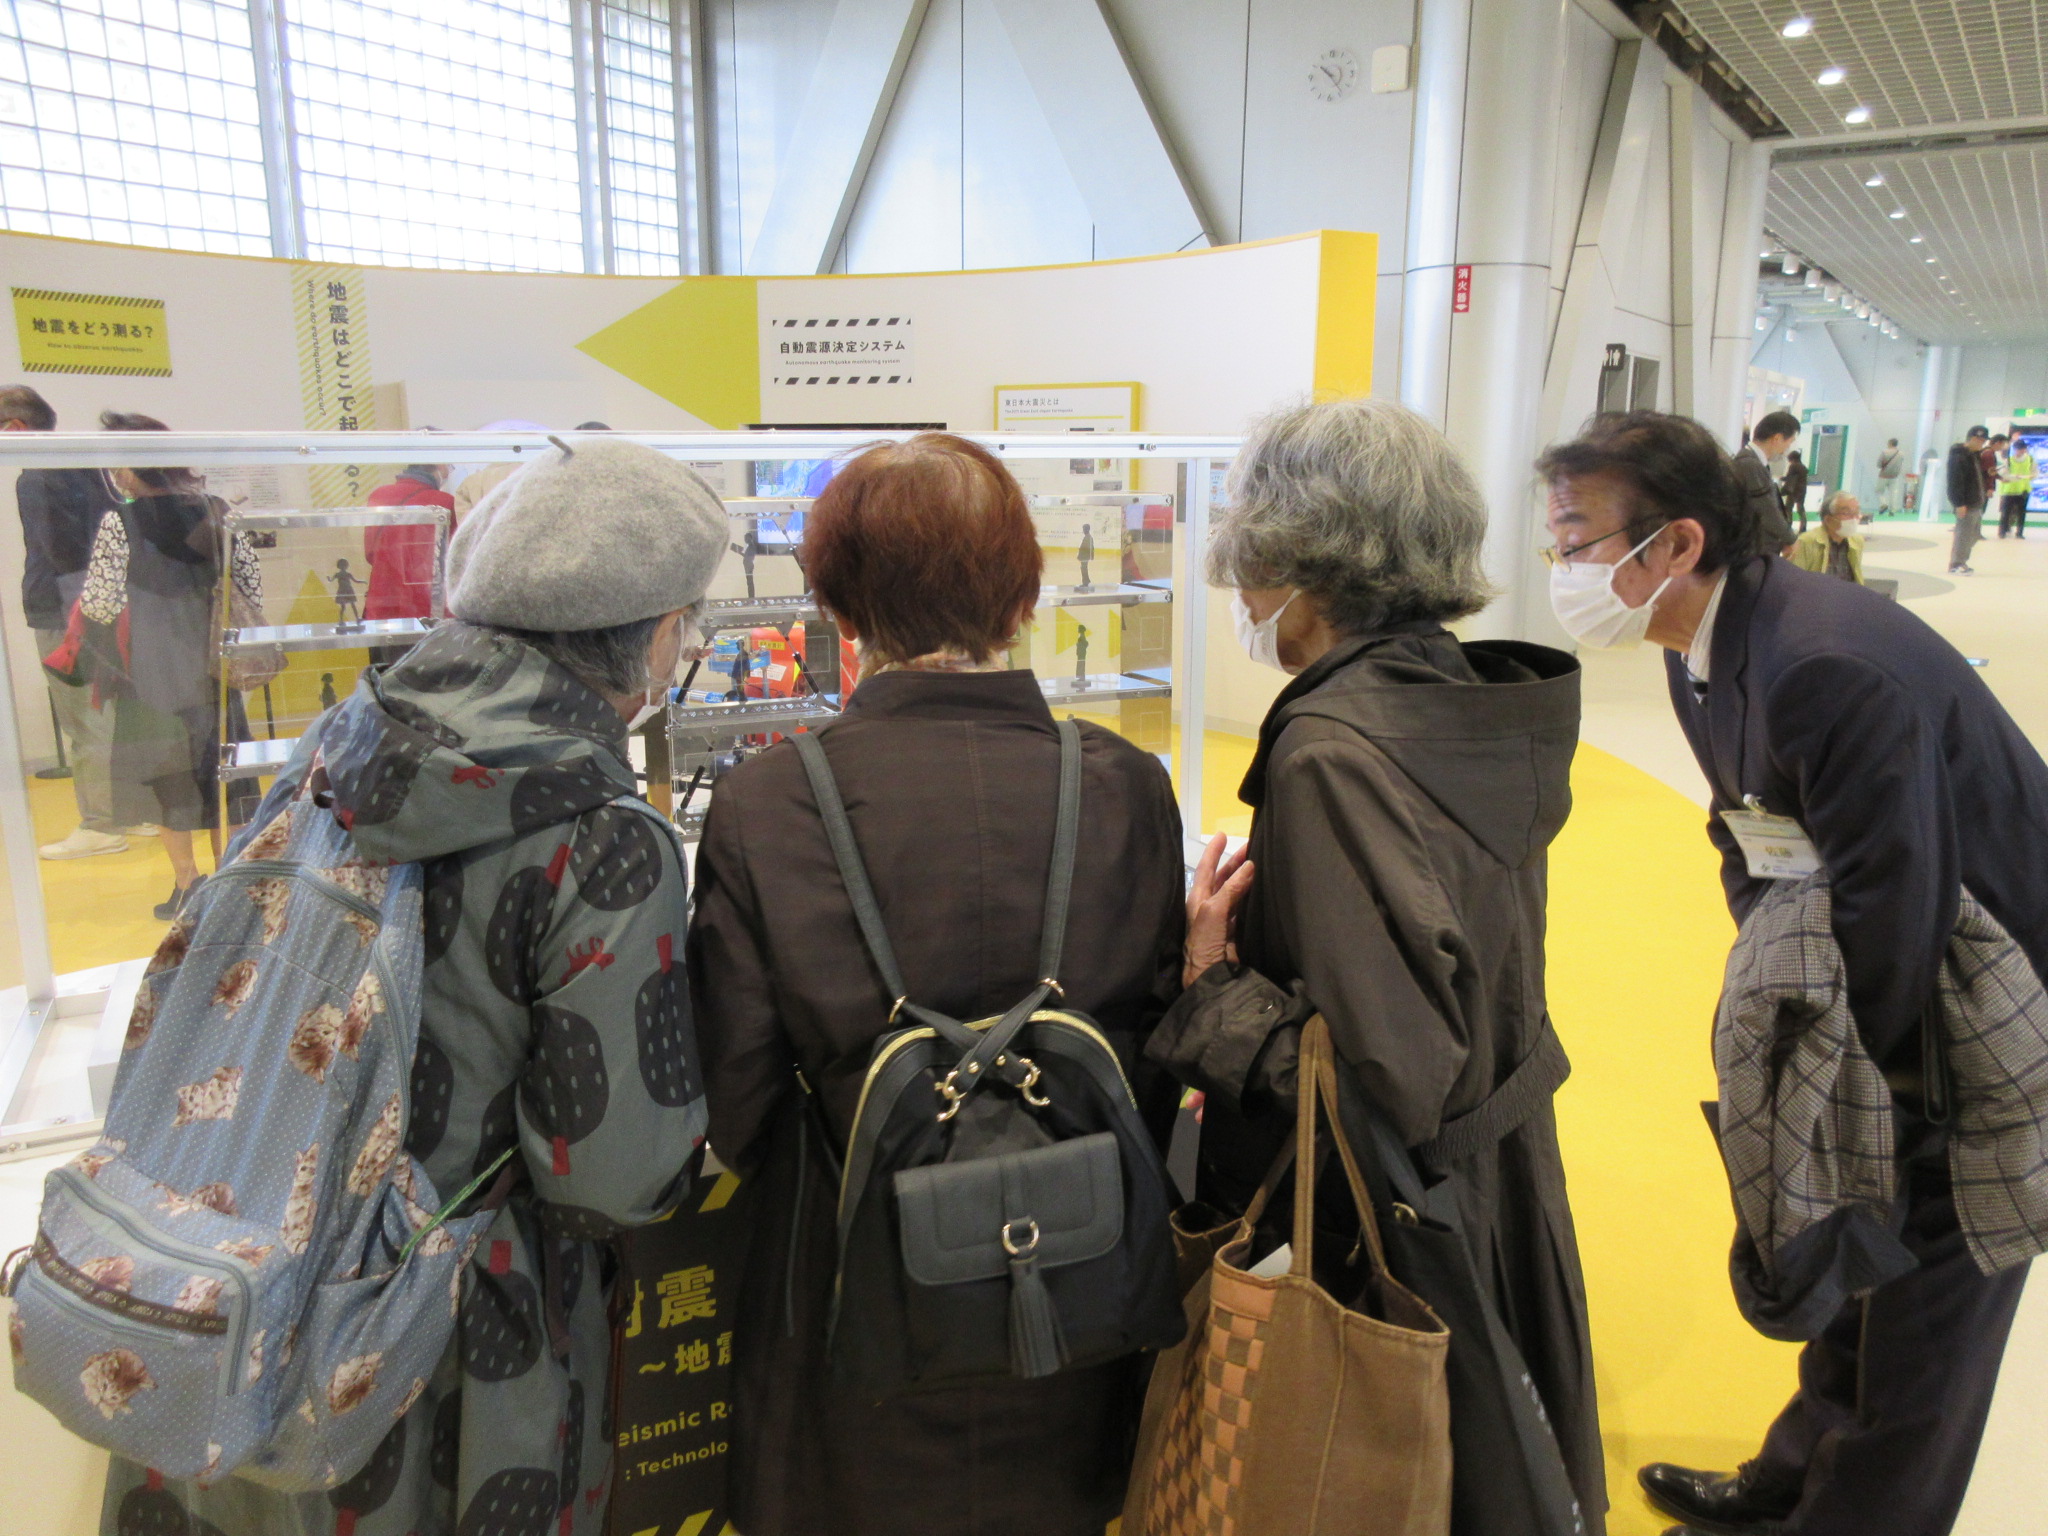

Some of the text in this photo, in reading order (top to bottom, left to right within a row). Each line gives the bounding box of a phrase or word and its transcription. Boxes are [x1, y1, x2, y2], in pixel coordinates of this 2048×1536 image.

[33, 318, 153, 338] 地震をどう測る？
[307, 280, 327, 416] Where do earthquakes occur?
[780, 340, 906, 354] 自動震源決定システム
[1005, 398, 1059, 407] 東日本大震災とは
[618, 1401, 733, 1447] eismic R
[637, 1441, 729, 1476] Technolo
